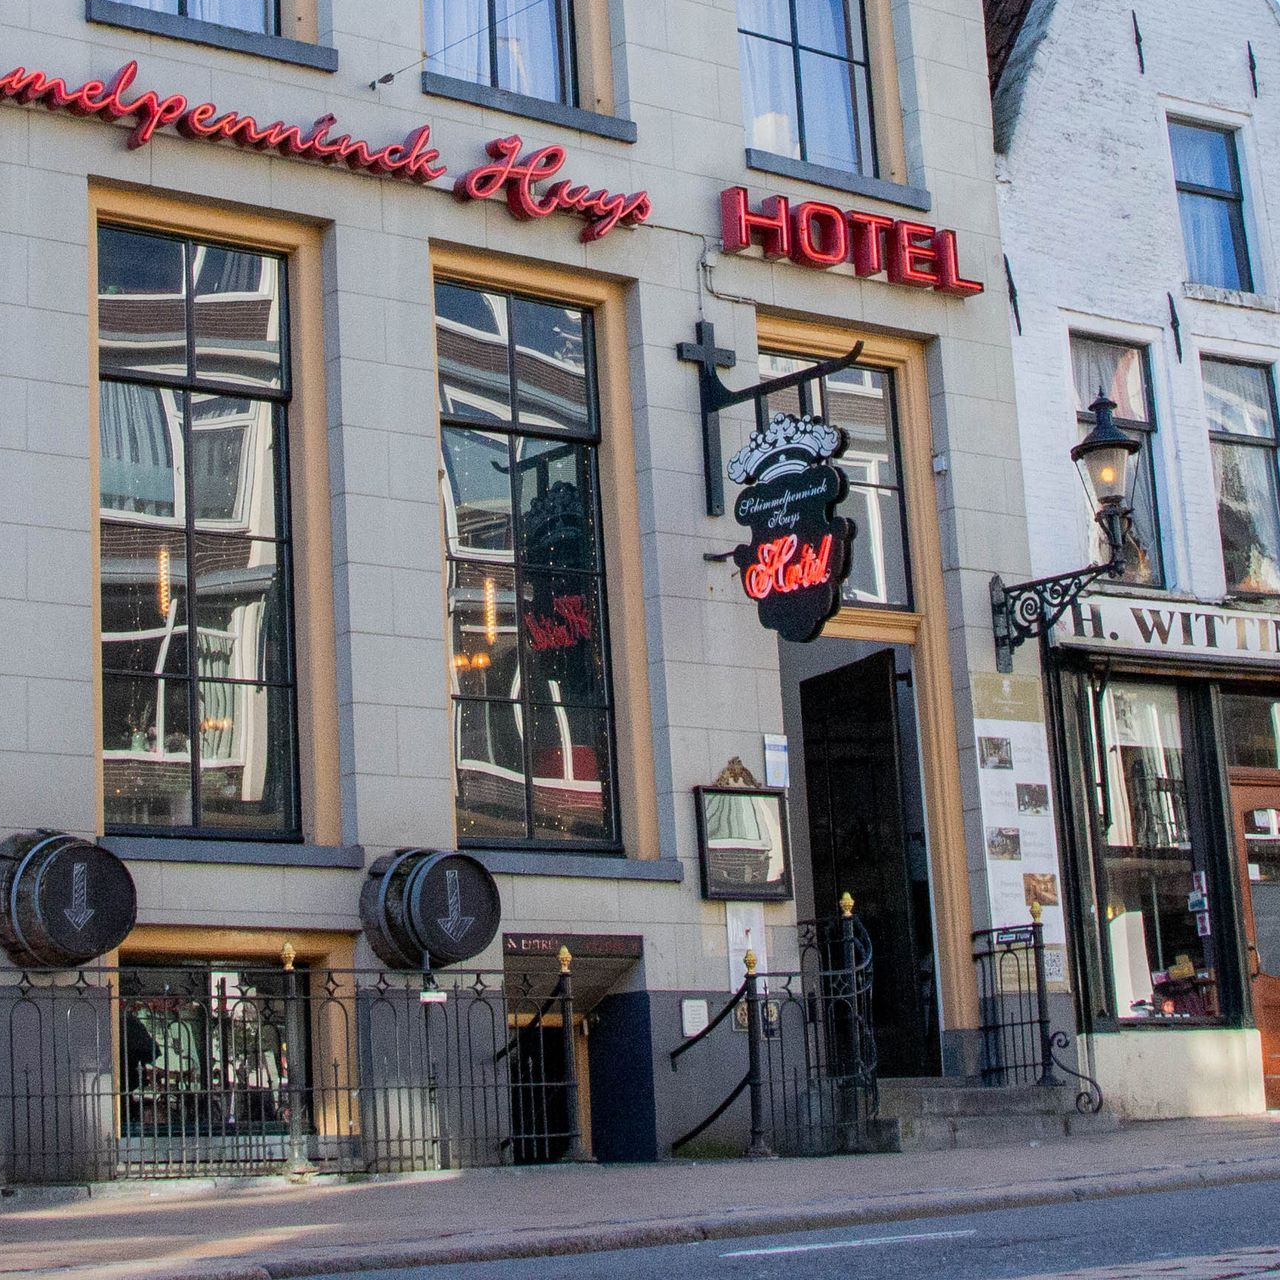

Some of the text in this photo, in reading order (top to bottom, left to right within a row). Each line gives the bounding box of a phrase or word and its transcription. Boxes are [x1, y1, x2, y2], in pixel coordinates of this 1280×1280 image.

[453, 133, 652, 242] Huys
[720, 186, 984, 297] HOTEL
[739, 478, 827, 516] Schimmelpenninck
[768, 511, 800, 529] Huys
[745, 534, 832, 599] Hotel
[1070, 601, 1119, 641] H.
